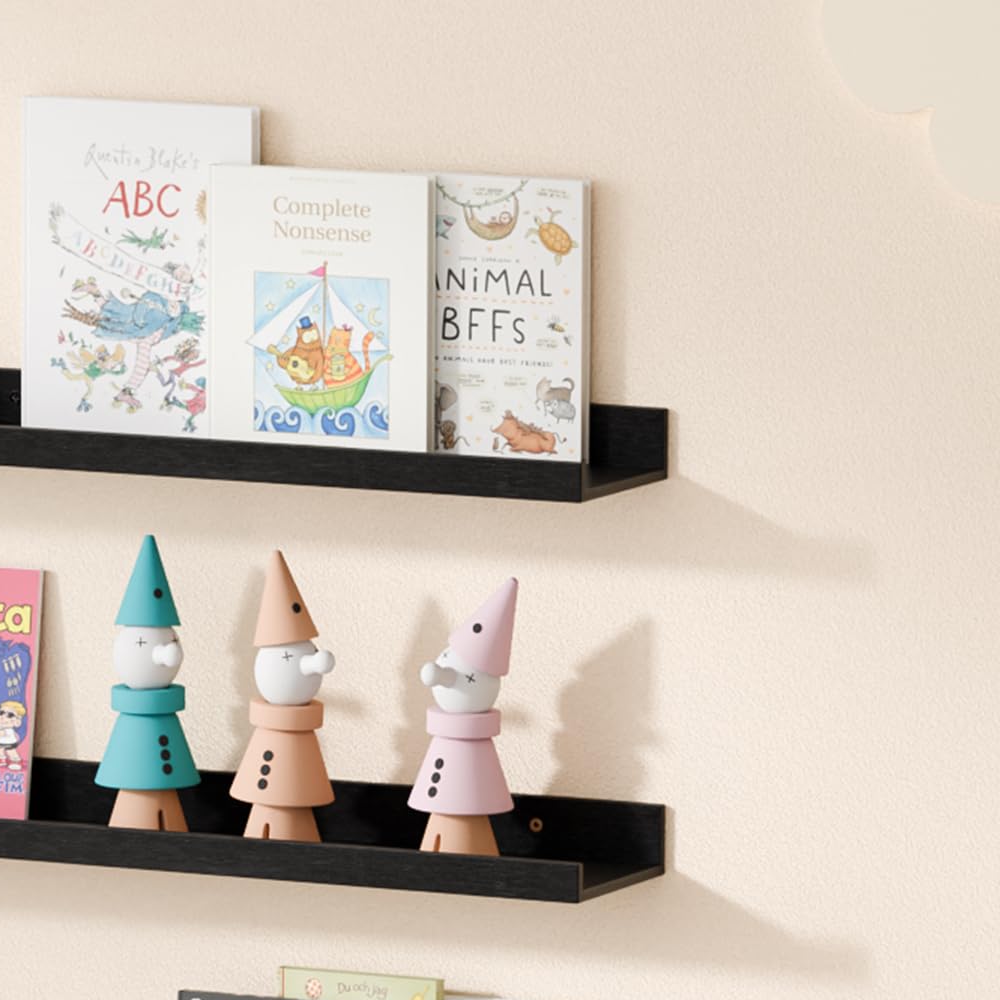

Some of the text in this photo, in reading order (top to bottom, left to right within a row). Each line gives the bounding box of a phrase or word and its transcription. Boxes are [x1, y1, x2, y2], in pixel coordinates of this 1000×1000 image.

[102, 180, 182, 219] ABC
[273, 195, 371, 221] Complete
[273, 220, 371, 242] Nonsense
